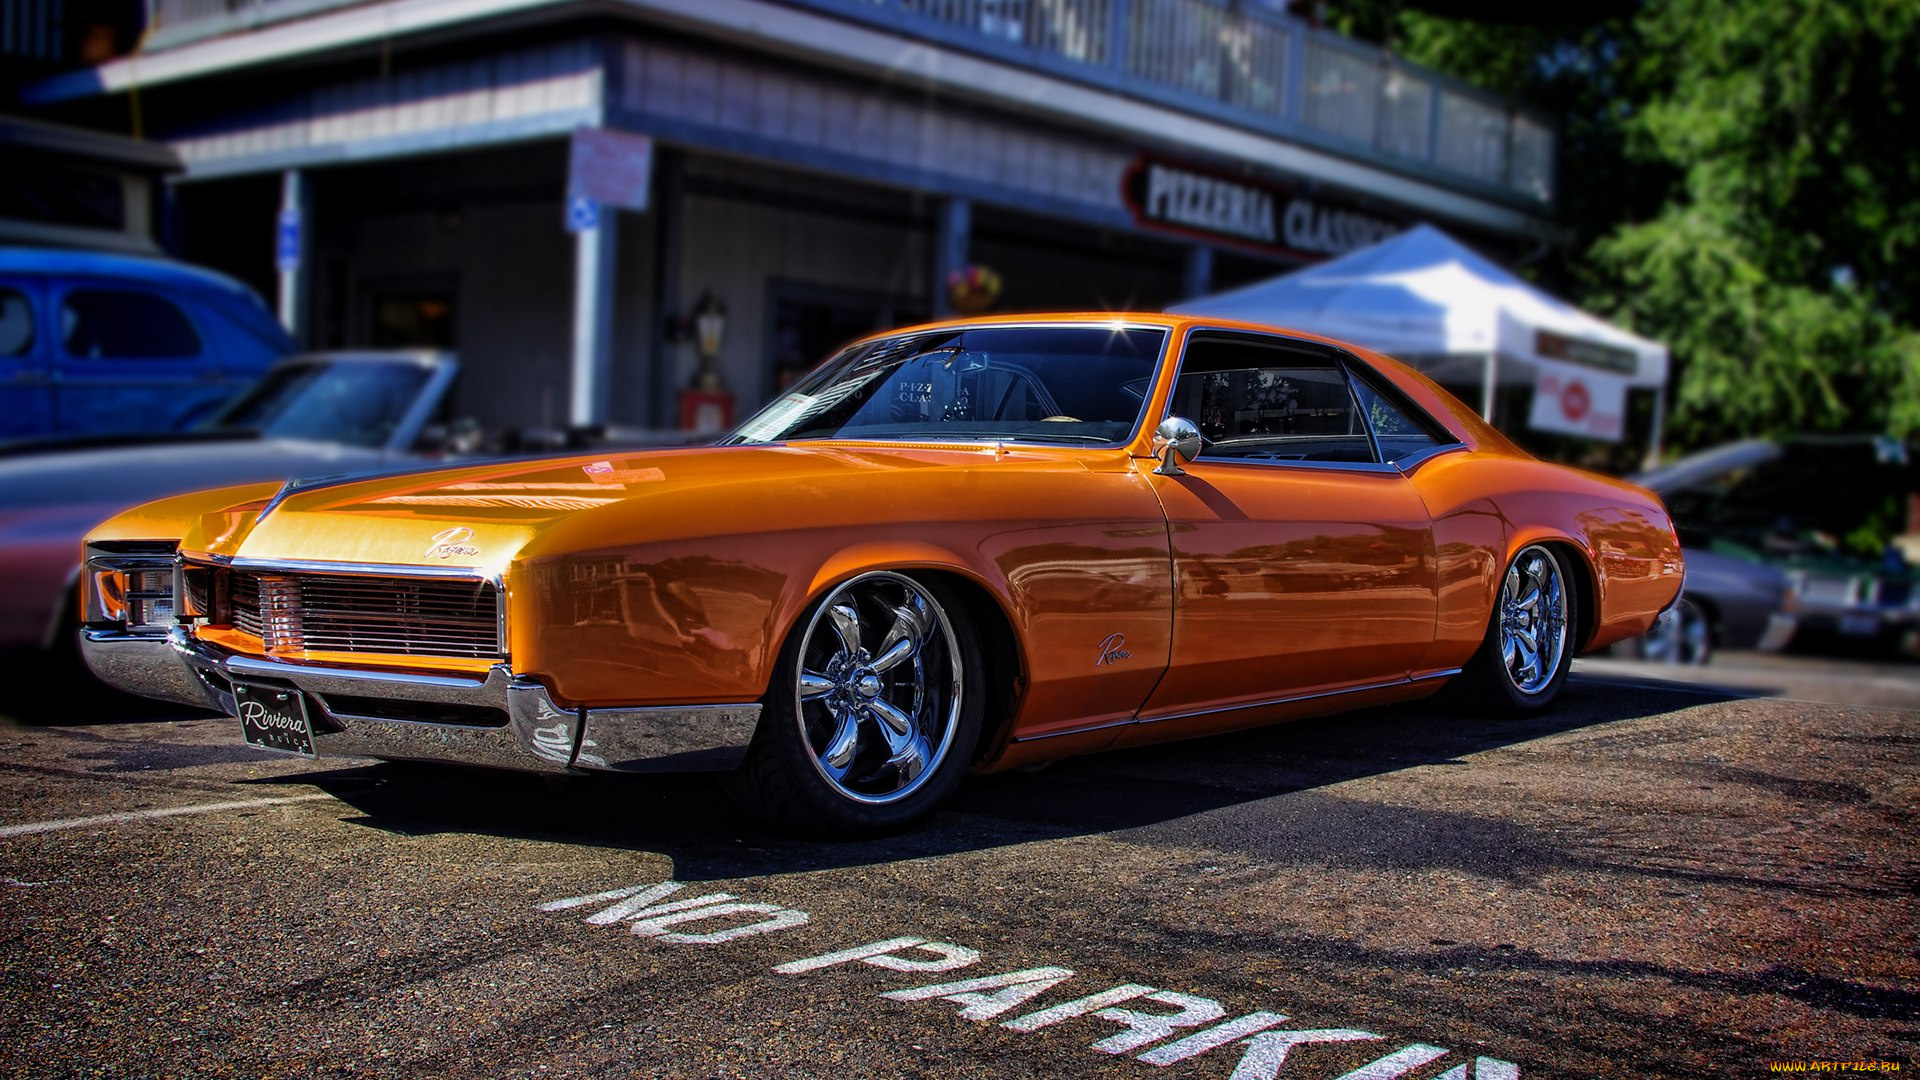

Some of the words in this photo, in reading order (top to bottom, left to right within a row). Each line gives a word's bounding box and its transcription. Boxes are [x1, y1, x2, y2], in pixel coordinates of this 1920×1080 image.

[1147, 164, 1276, 243] PIZZERIA
[240, 701, 307, 734] Riviera
[535, 881, 810, 945] NO
